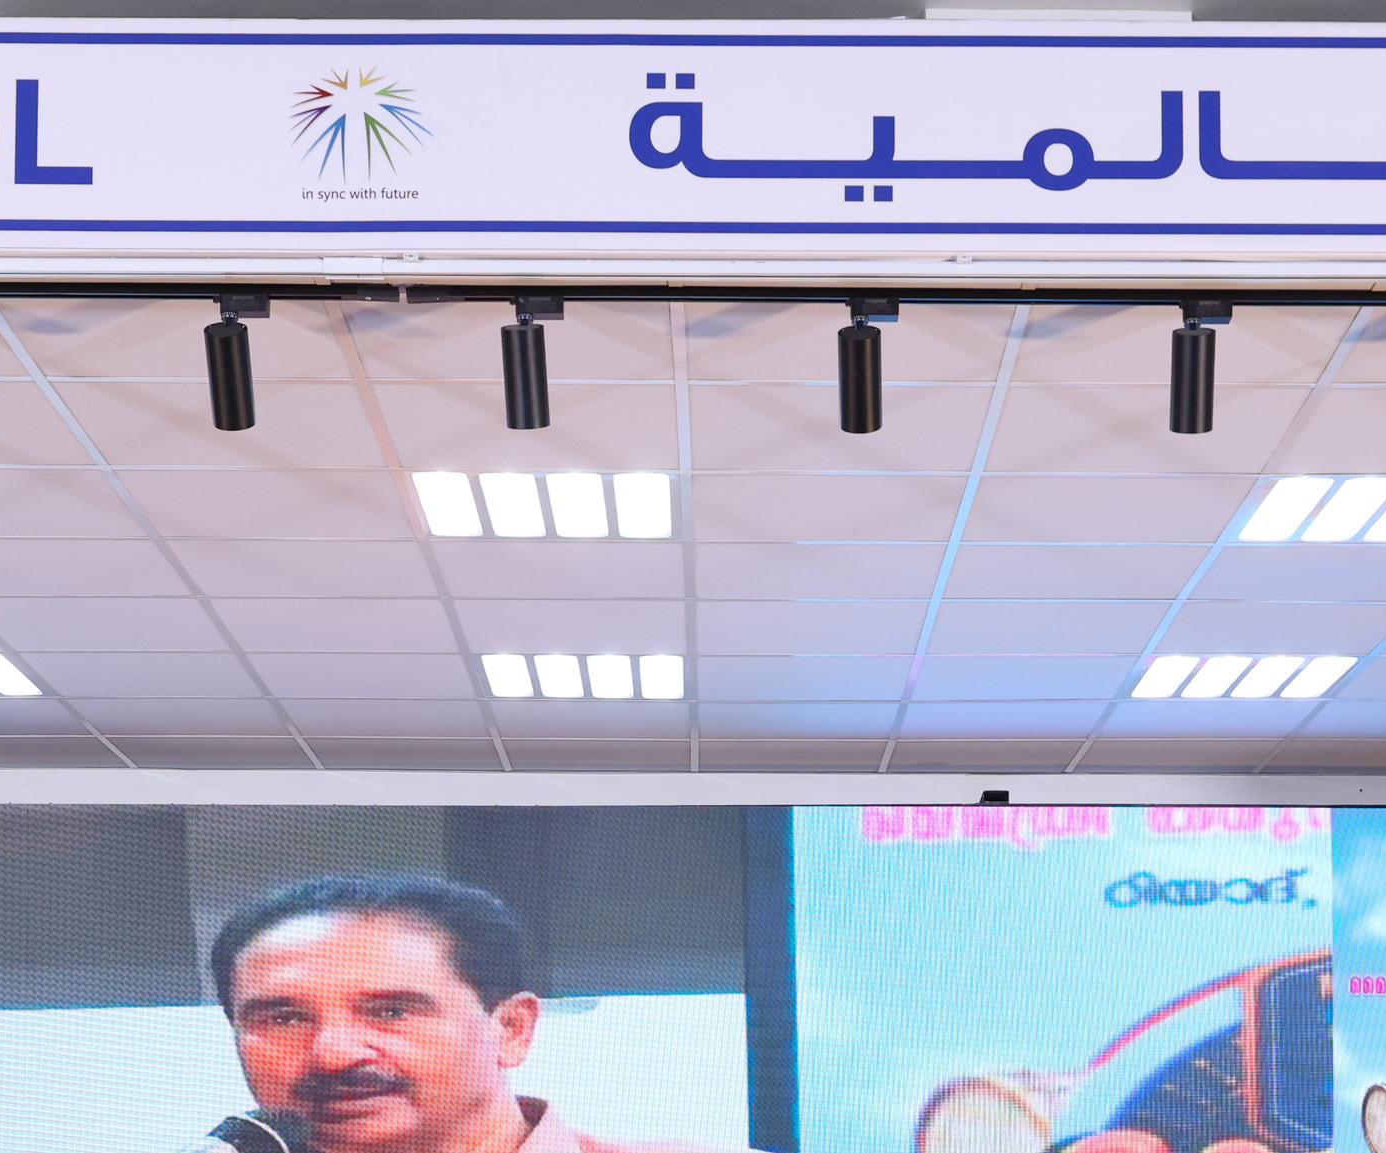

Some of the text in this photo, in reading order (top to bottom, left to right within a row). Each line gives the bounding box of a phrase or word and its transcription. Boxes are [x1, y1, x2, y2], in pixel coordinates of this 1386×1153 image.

[302, 187, 419, 203] in sync with future
